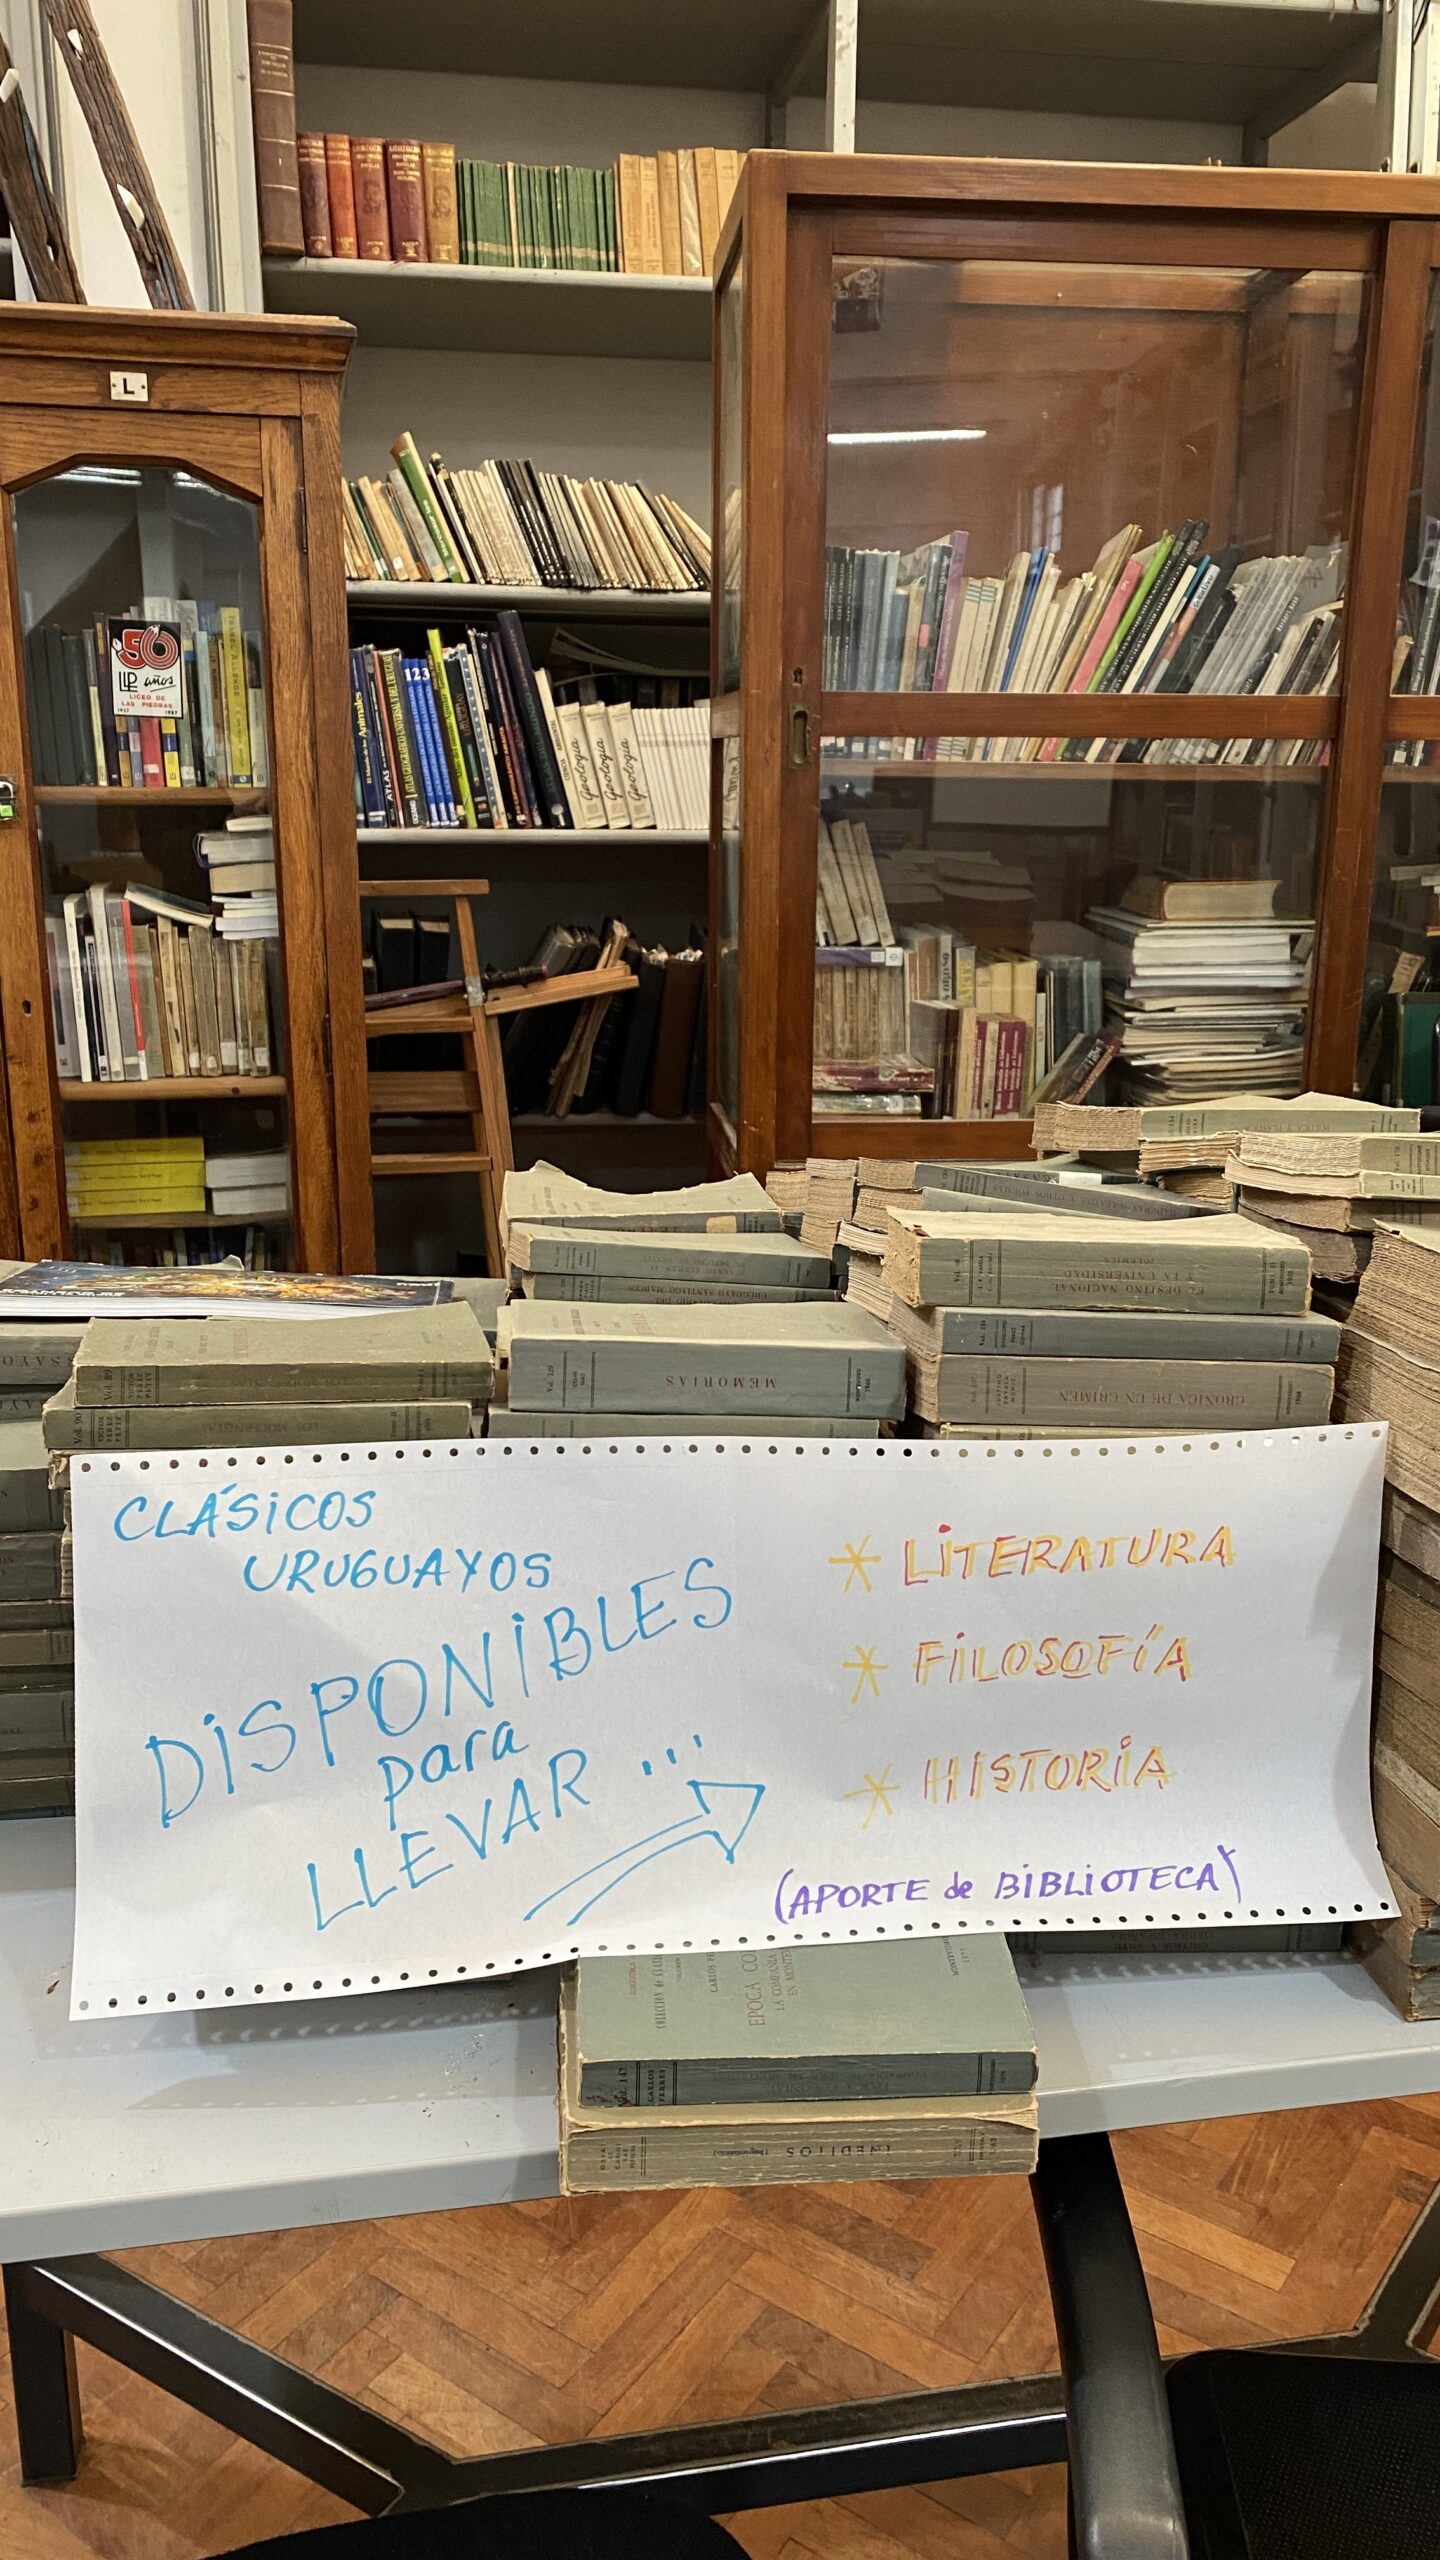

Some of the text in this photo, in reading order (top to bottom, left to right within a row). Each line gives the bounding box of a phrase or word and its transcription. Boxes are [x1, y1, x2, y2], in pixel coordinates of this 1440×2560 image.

[122, 377, 135, 395] L
[144, 674, 174, 687] años
[404, 668, 412, 681] 1
[412, 667, 421, 680] 2
[422, 668, 430, 680] 3
[355, 691, 368, 738] Animales
[384, 770, 394, 801] ATLAS
[402, 774, 413, 793] ATLAS
[1063, 1269, 1155, 1281] UNIVERSIDAD
[1163, 1271, 1178, 1281] LA
[668, 1287, 714, 1297] SANTIAGO
[1051, 1283, 1204, 1296] EL DESTINO NACIONAL
[2, 1355, 73, 1367] SAYO
[665, 1374, 776, 1389] MEMORIAS
[104, 1385, 113, 1401] Vol.
[1058, 1390, 1245, 1405] CRONICA DE UN CRIMEN
[74, 1425, 82, 1445] Vol.
[244, 1548, 551, 1593] URUGUAYOS
[379, 1720, 528, 1830] para
[307, 1749, 591, 1931] LLEVAR
[944, 1871, 973, 1902] de
[707, 1964, 718, 1993] CARLOS
[787, 1985, 798, 1997] EN
[653, 1992, 666, 2029] COLECCION
[745, 1982, 766, 2026] EPOCA
[618, 2067, 627, 2083] 147
[786, 2144, 891, 2159] INEDITOS
